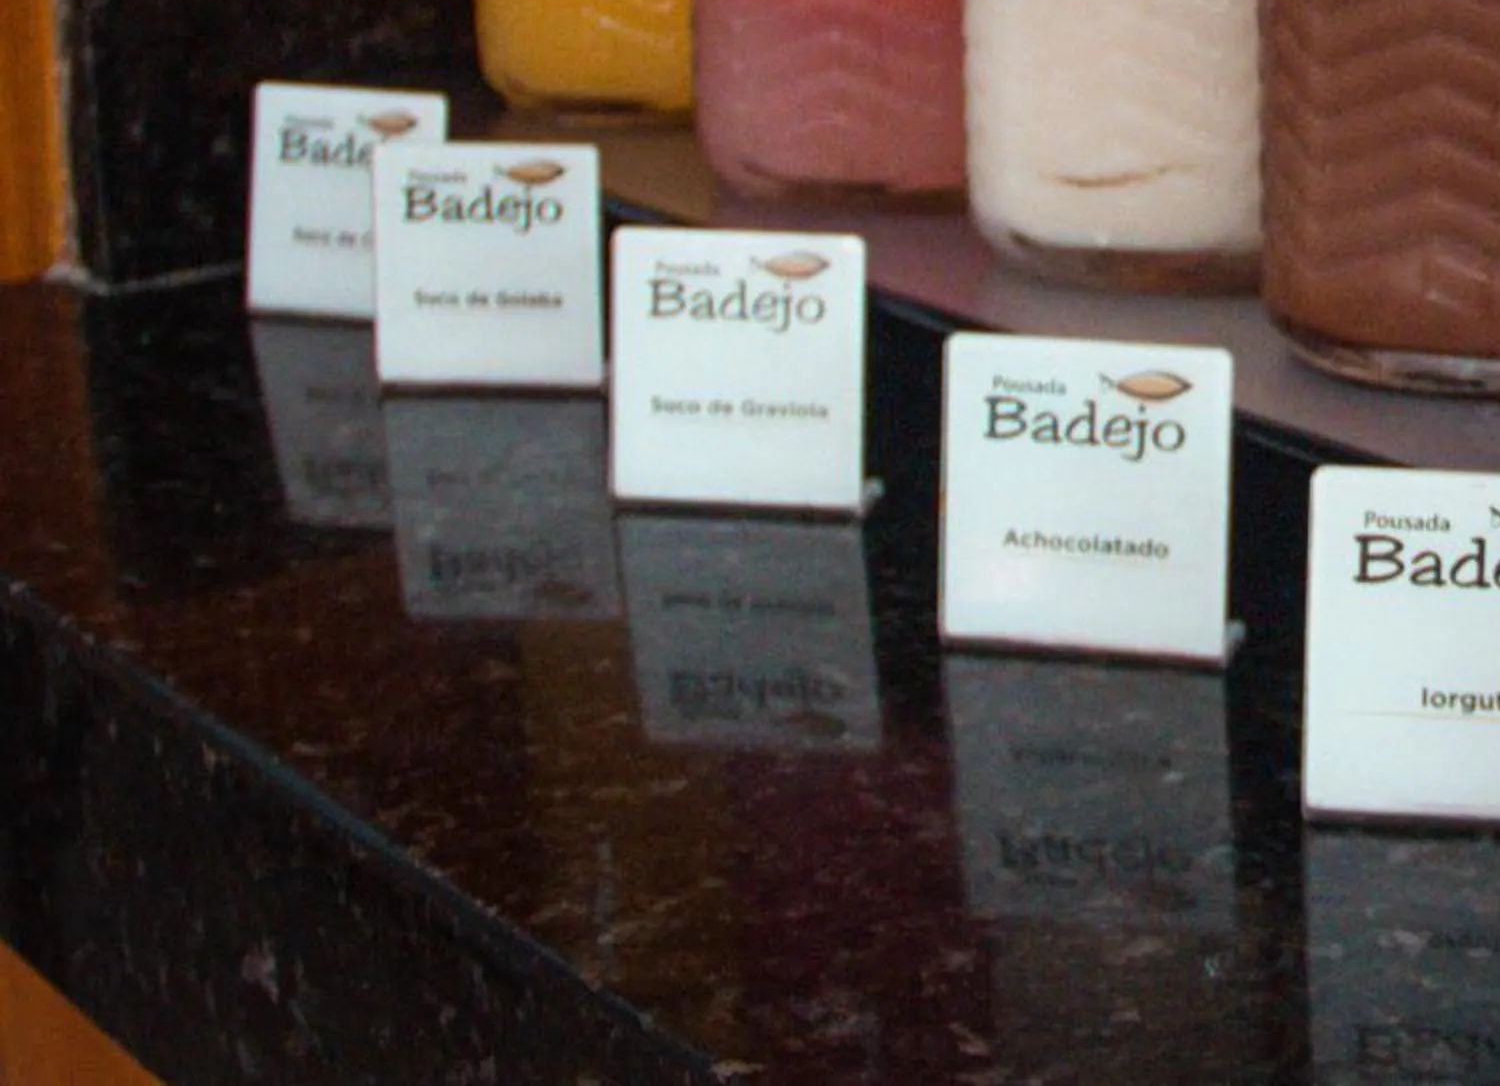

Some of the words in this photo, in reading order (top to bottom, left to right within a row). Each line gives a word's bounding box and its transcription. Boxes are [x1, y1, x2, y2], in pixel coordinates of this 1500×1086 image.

[278, 127, 374, 170] Bade
[403, 183, 563, 235] Badejo
[646, 277, 826, 334] Badejo
[992, 374, 1067, 396] Pousada
[650, 395, 701, 415] Suco
[707, 397, 733, 416] de
[741, 399, 829, 419] Graviola
[983, 394, 1187, 462] Badejo
[1363, 511, 1451, 533] Pousada
[1002, 529, 1170, 560] Achocolatado
